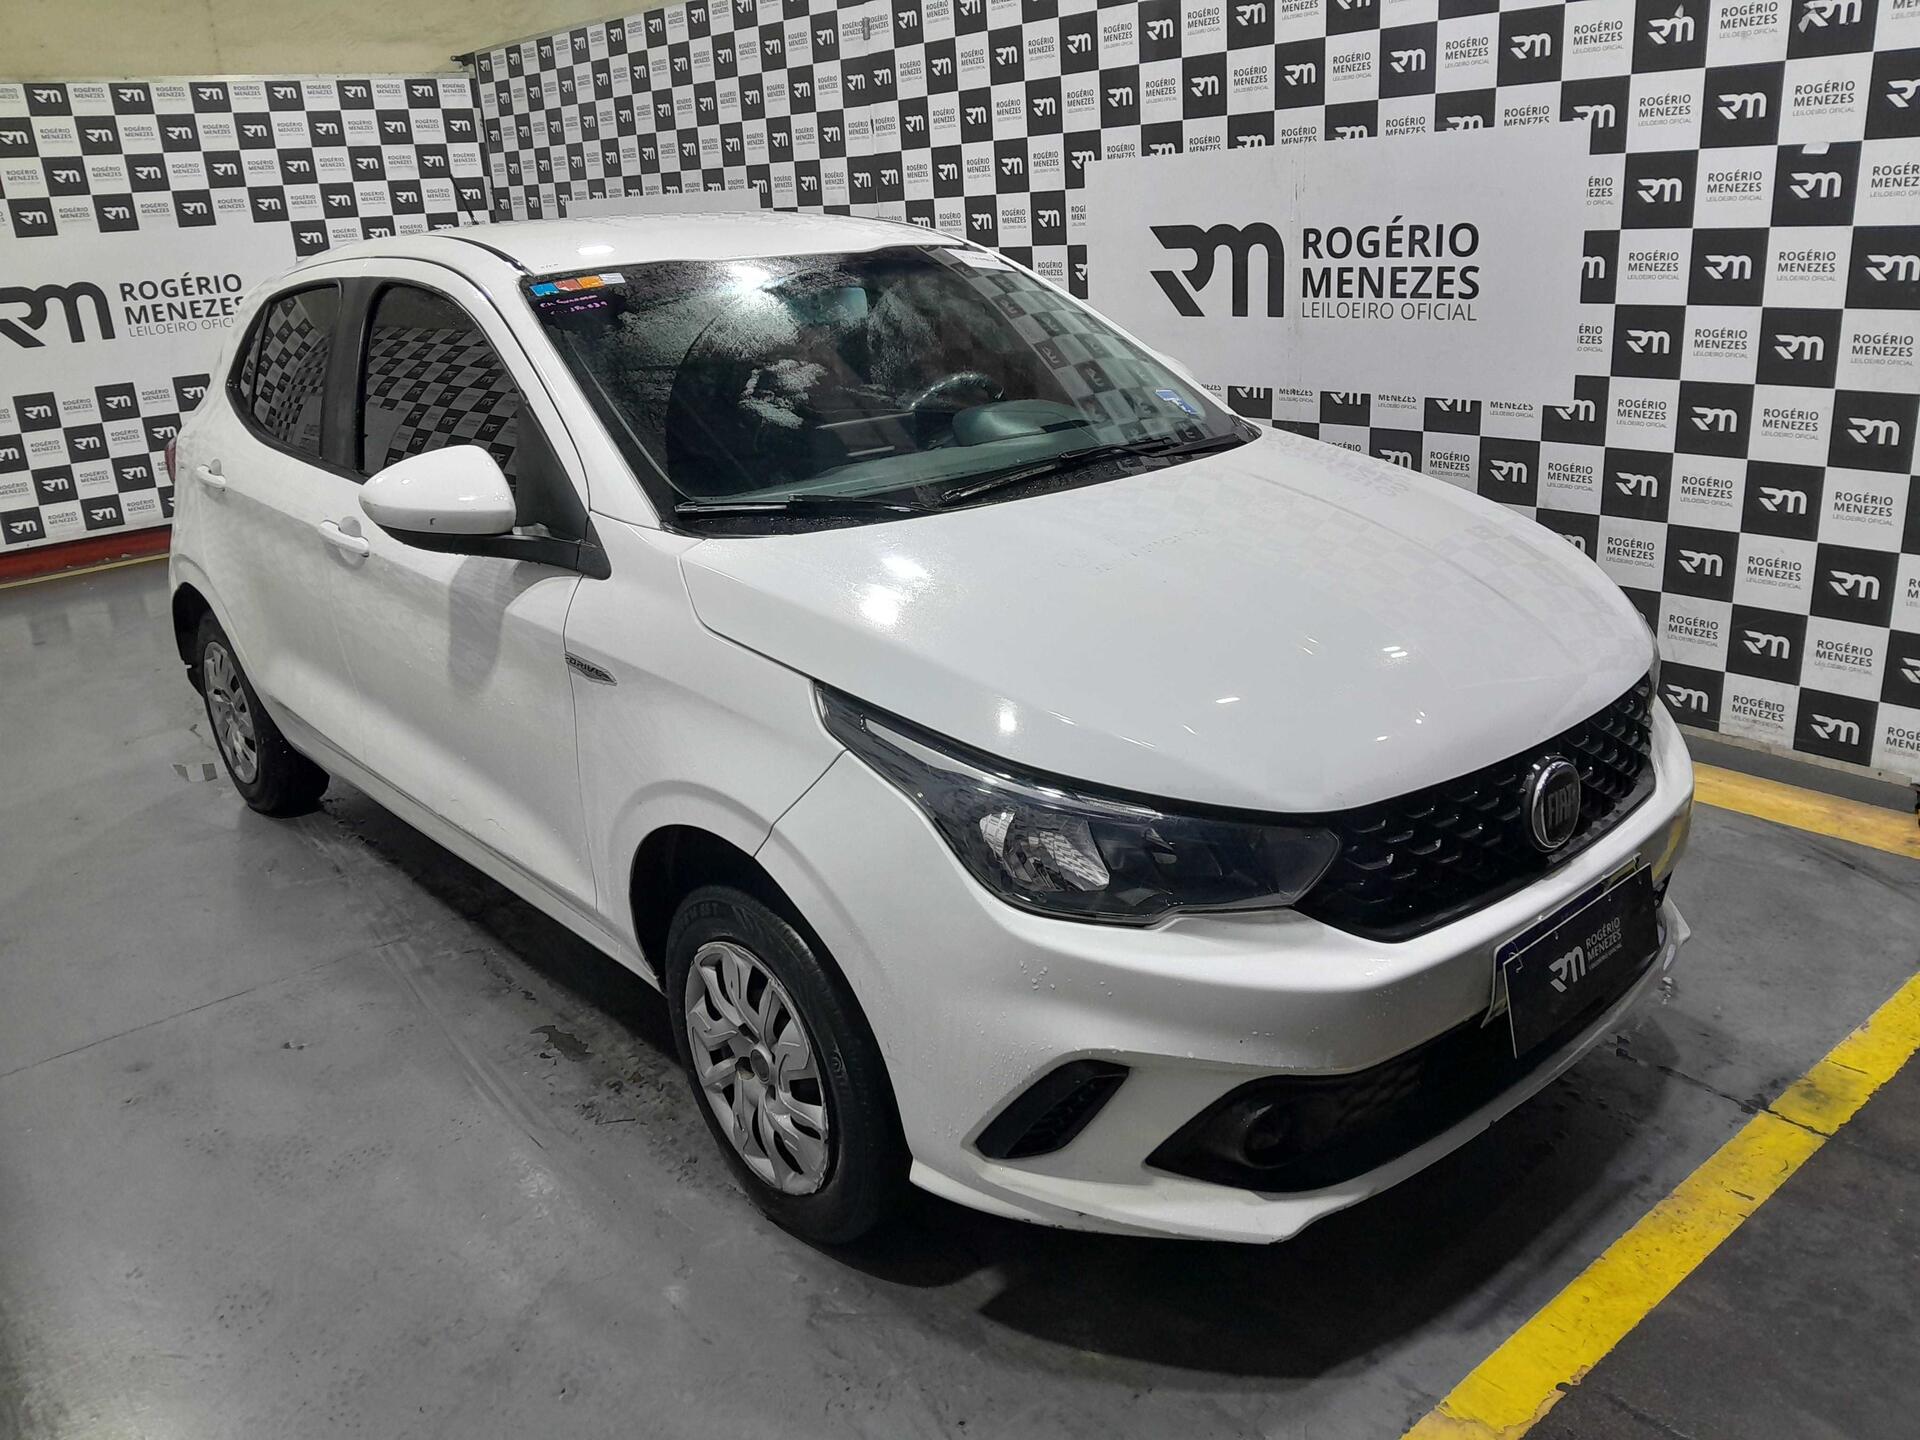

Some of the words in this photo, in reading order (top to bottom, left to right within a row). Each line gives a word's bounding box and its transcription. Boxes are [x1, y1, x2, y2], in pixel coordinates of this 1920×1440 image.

[1187, 6, 1220, 20] ROGÉRIO
[1721, 1, 1778, 18] ROGÉRIO
[1187, 16, 1220, 29] MENEZES
[1573, 20, 1623, 35] ROGÉRIO
[1720, 13, 1778, 29] MENEZES
[1103, 22, 1132, 34] ROGÉRIO
[1028, 36, 1054, 47] ROGÉRIO
[1103, 30, 1133, 43] MENEZES
[1445, 36, 1489, 50] ROGÉRIO
[1573, 31, 1623, 46] MENEZES
[960, 48, 984, 59] ROGÉRIO
[1028, 44, 1055, 55] MENEZES
[1445, 46, 1489, 60] MENEZES
[961, 56, 985, 66] MENEZES
[1333, 51, 1371, 64] ROGÉRIO
[1233, 65, 1267, 77] ROGÉRIO
[1333, 61, 1371, 74] MENEZES
[1145, 78, 1176, 89] ROGÉRIO
[1233, 74, 1268, 87] MENEZES
[1067, 88, 1094, 99] ROGÉRIO
[1145, 86, 1176, 97] MENEZES
[1795, 80, 1855, 95] ROGÉRIO
[996, 98, 1021, 109] ROGÉRIO
[1067, 96, 1095, 107] MENEZES
[1639, 92, 1691, 107] ROGÉRIO
[1793, 92, 1854, 107] MENEZES
[996, 106, 1021, 116] MENEZES
[1504, 105, 1550, 119] ROGÉRIO
[1638, 104, 1691, 118] MENEZES
[1385, 116, 1426, 130] ROGÉRIO
[1281, 126, 1317, 139] ROGÉRIO
[966, 157, 990, 166] ROGÉRIO
[1032, 150, 1059, 160] ROGÉRIO
[967, 164, 991, 173] MENEZES
[1033, 158, 1059, 168] MENEZES
[1707, 168, 1762, 182] ROGÉRIO
[1707, 182, 1762, 194] MENEZES
[1001, 208, 1026, 217] ROGÉRIO
[1002, 216, 1027, 224] MENEZES
[1302, 215, 1479, 259] ROGÉRIO
[1628, 249, 1679, 262] ROGÉRIO
[1778, 248, 1836, 261] ROGÉRIO
[1628, 262, 1679, 272] MENEZES
[1777, 262, 1835, 273] MENEZES
[119, 272, 242, 302] ROGÉRIO
[1302, 266, 1480, 300] MENEZES
[1302, 302, 1394, 319] LEILOEIRO
[1401, 303, 1477, 321] OFICIAL
[129, 321, 197, 337] LEILOEIRO
[201, 317, 234, 330] OFIC
[1695, 327, 1748, 340] ROGÉRIO
[1694, 339, 1747, 350] MENEZES
[1853, 332, 1914, 346] ROGÉRIO
[1851, 345, 1913, 357] MENEZES
[1618, 398, 1667, 410] ROGÉRIO
[1617, 408, 1667, 420] MENEZES
[1763, 408, 1819, 421] ROGÉRIO
[1762, 418, 1818, 432] MENEZES
[1548, 462, 1593, 475] ROGÉRIO
[1547, 471, 1593, 484] MENEZES
[1682, 475, 1733, 489] ROGÉRIO
[1681, 486, 1733, 499] MENEZES
[1835, 491, 1893, 506] ROGÉRIO
[1834, 502, 1893, 517] MENEZES
[1607, 536, 1655, 551] ROGÉRIO
[1606, 546, 1655, 561] MENEZES
[1748, 556, 1802, 571] ROGÉRIO
[1747, 566, 1801, 582] MENEZES
[1669, 614, 1719, 630] ROGÉRIO
[1668, 624, 1718, 640] MENEZES
[1817, 639, 1873, 657] ROGÉRIO
[1815, 649, 1872, 667] MENEZES
[1733, 694, 1785, 713] ROGÉRIO
[1732, 704, 1785, 722] MENEZES
[1586, 917, 1620, 949] ROGÉRIO
[1587, 929, 1622, 960] MENEZES
